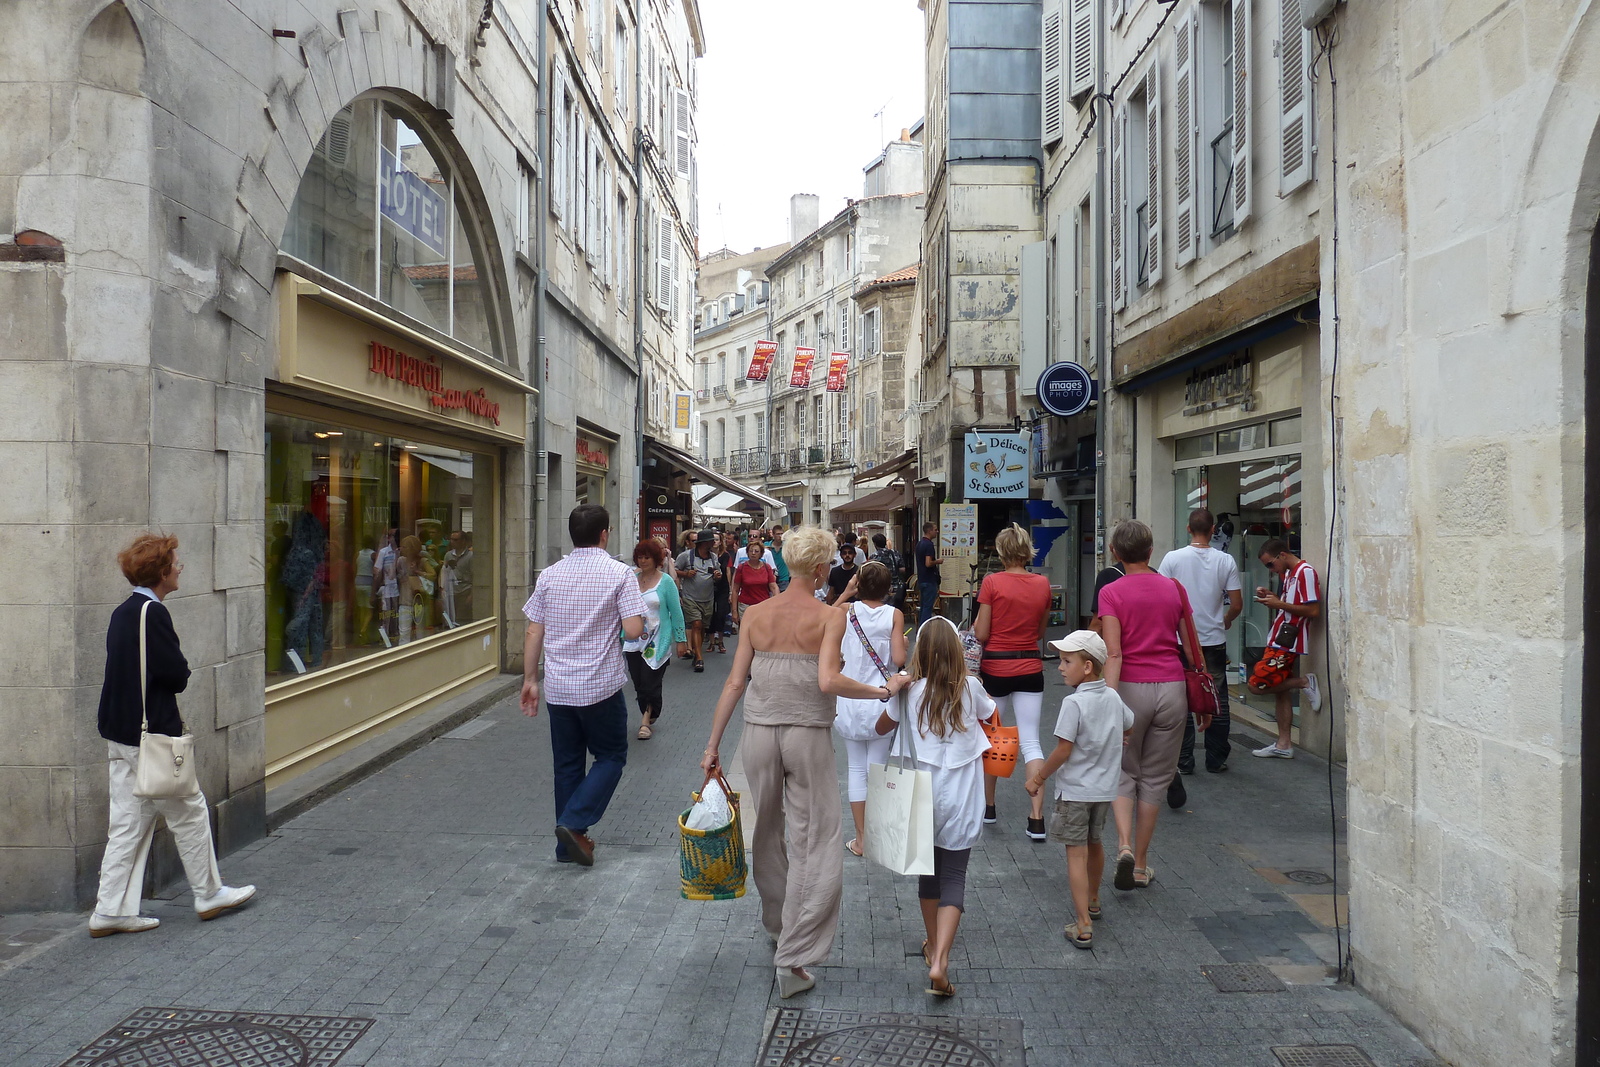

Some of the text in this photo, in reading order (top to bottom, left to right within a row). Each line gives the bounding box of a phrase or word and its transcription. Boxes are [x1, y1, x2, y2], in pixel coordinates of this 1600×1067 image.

[1049, 382, 1082, 391] images
[990, 437, 1027, 454] Délices
[969, 478, 1024, 494] St Sauveur
